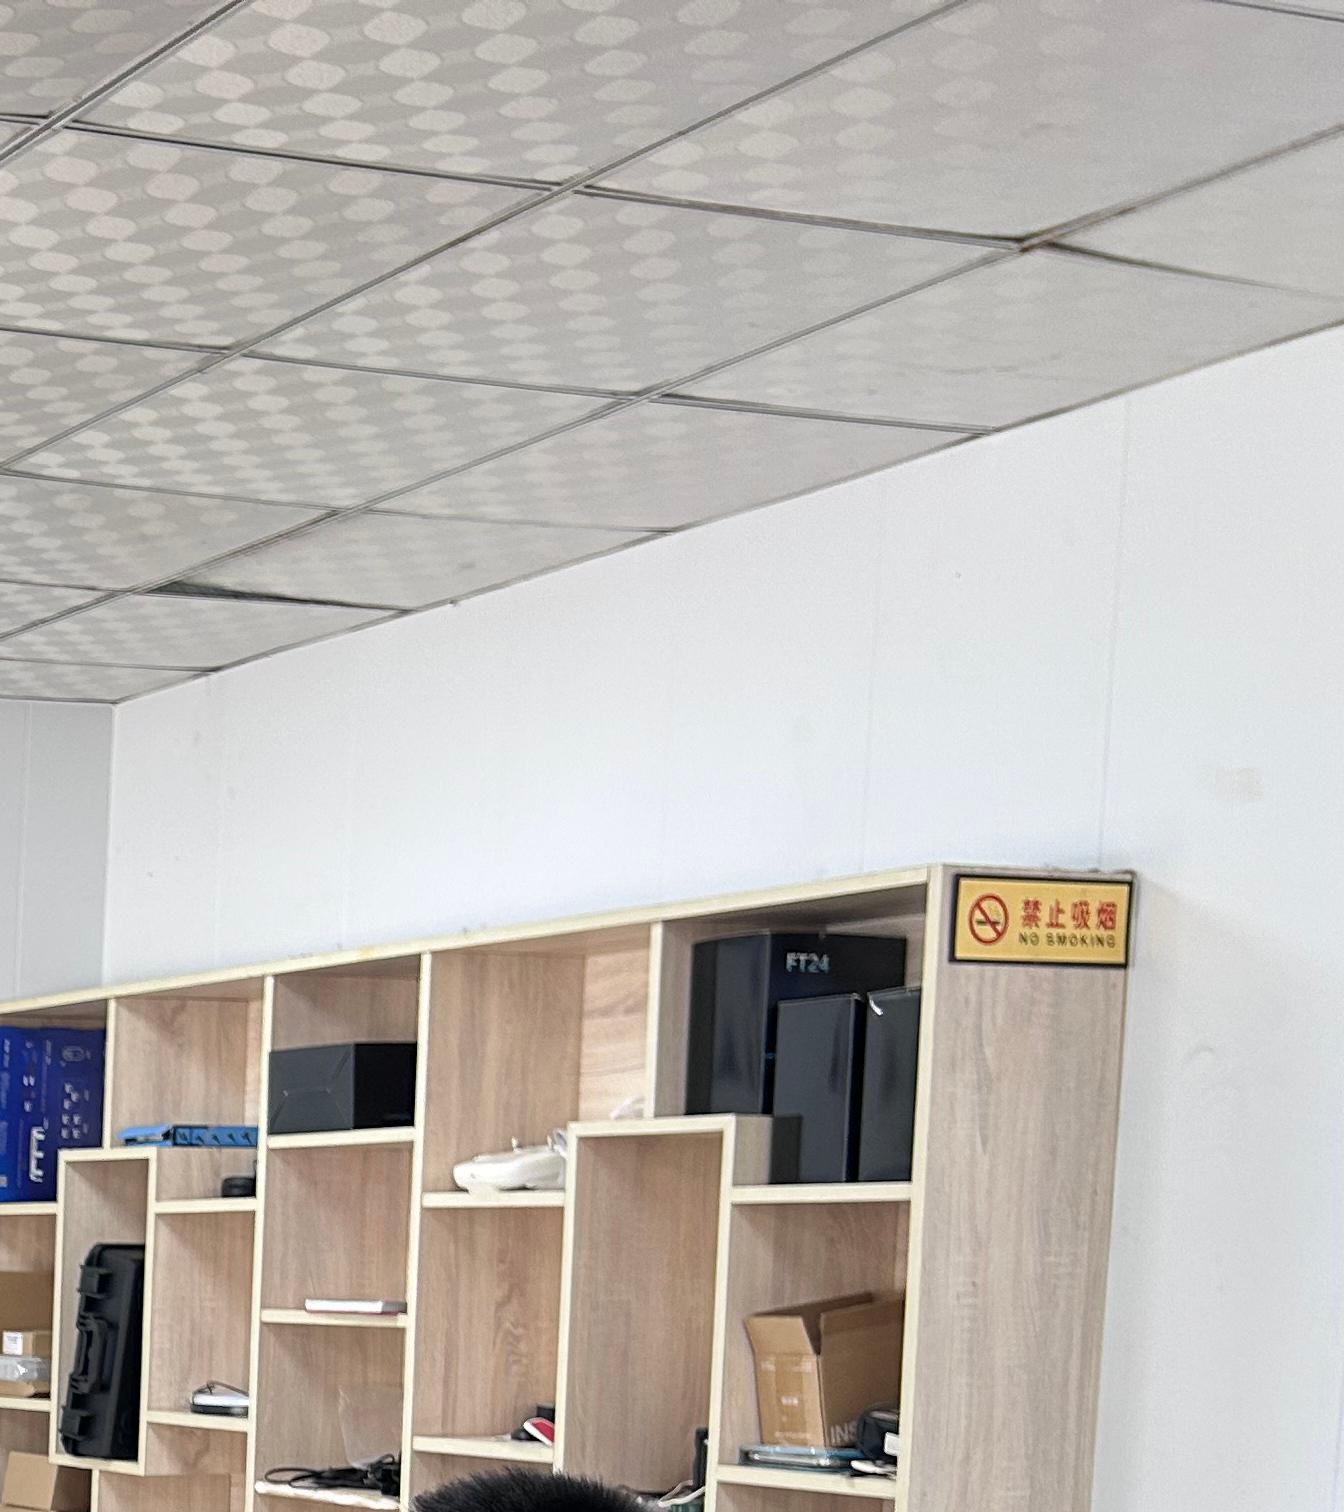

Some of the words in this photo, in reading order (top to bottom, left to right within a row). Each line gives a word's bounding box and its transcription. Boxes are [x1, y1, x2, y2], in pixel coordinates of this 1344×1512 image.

[1021, 898, 1118, 931] 禁止吸烟
[1018, 932, 1040, 946] NO
[1046, 933, 1116, 948] SMOKING
[786, 952, 830, 973] FT24
